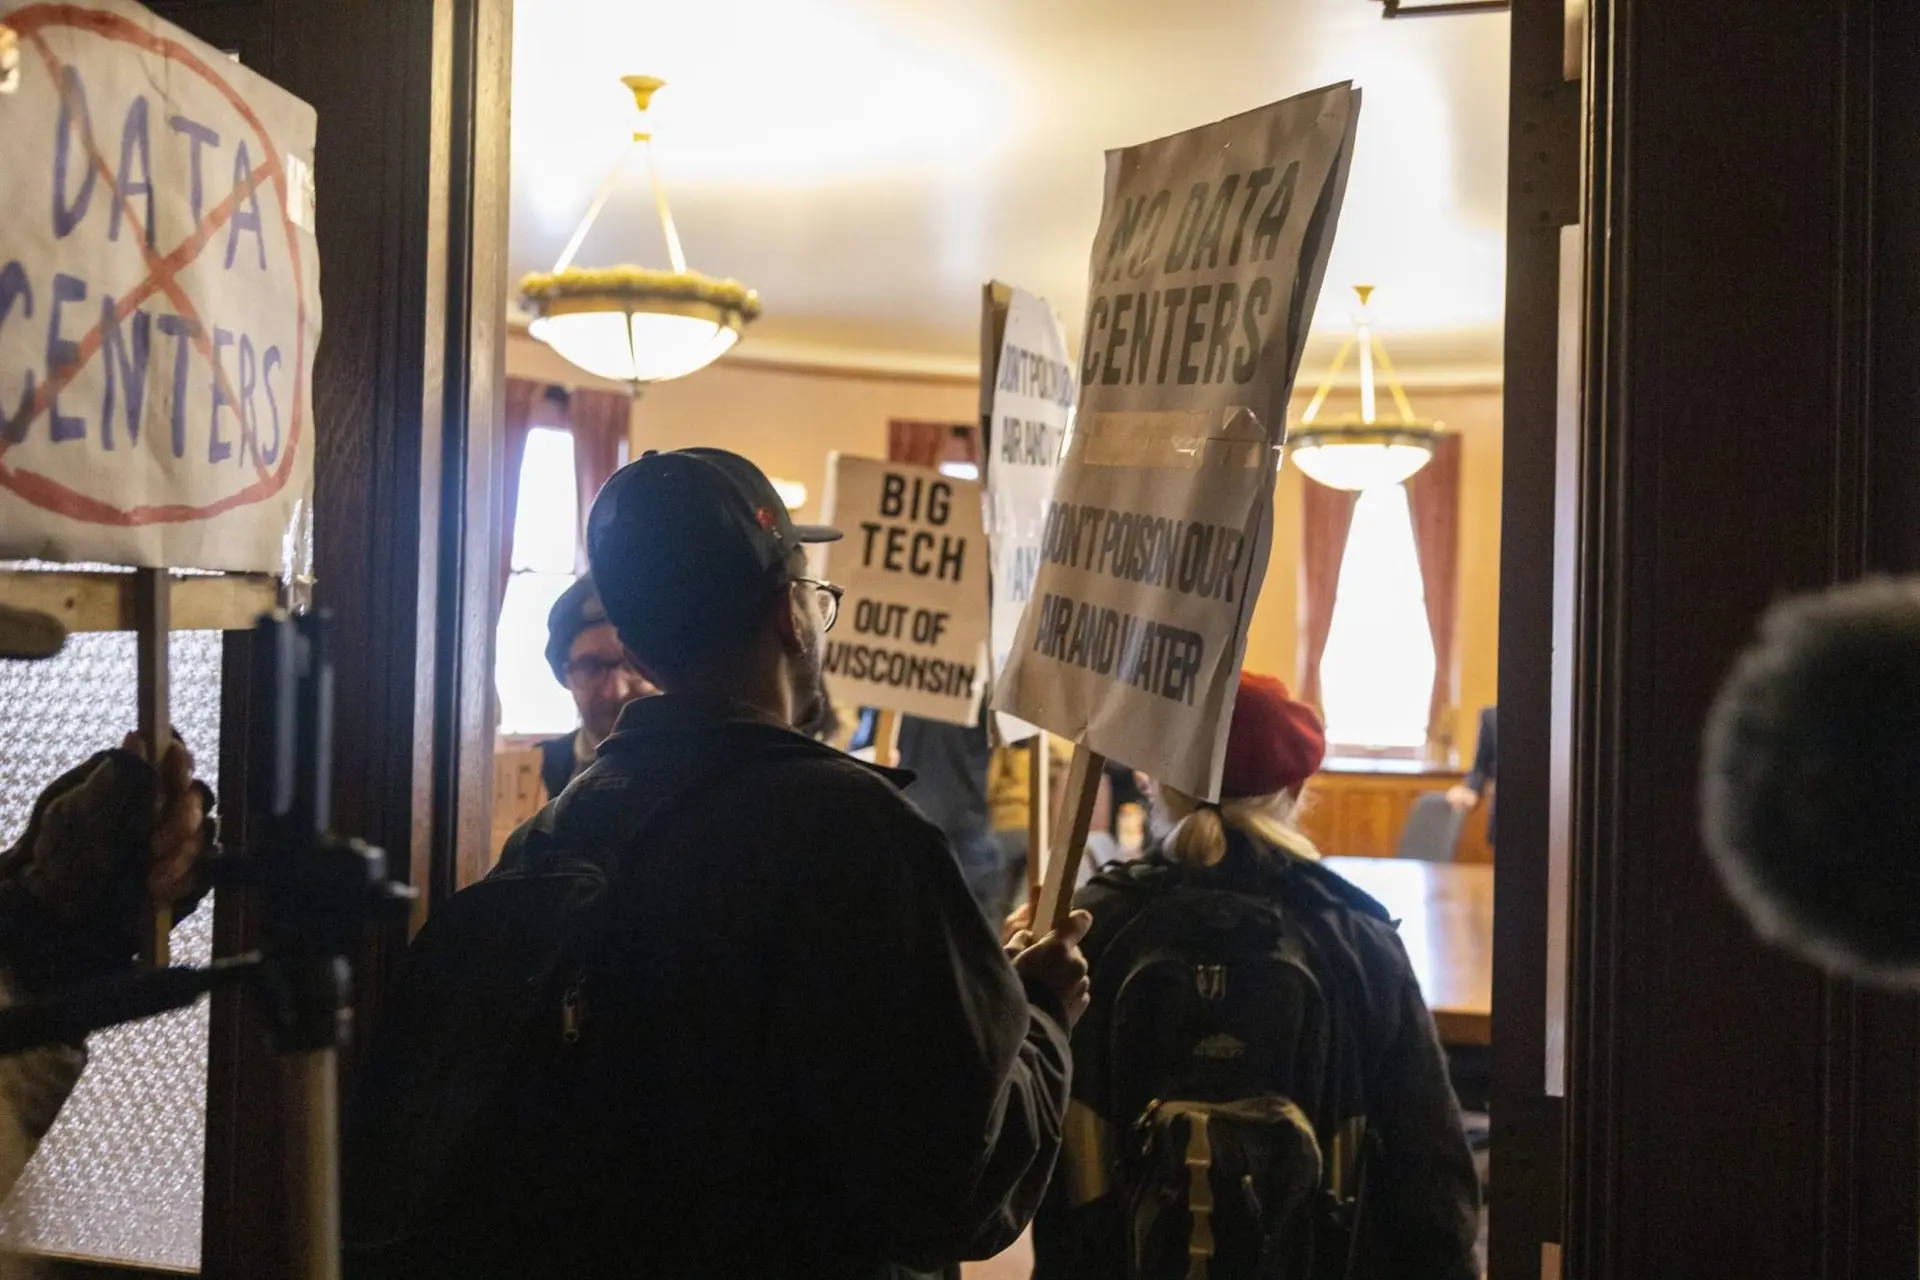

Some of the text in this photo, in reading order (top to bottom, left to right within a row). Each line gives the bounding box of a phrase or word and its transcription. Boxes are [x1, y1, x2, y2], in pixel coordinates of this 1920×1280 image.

[52, 64, 267, 271] DATA
[1099, 160, 1301, 284] NO DATA
[0, 260, 281, 469] CENTERS
[1081, 276, 1273, 386] CENTERS
[880, 472, 953, 526] BIG
[860, 522, 967, 583] TECH
[1097, 510, 1184, 590] POISON
[1178, 521, 1244, 603] OUR
[853, 598, 951, 646] OUT OF
[1033, 593, 1074, 663] AIR
[1066, 603, 1119, 675] AND
